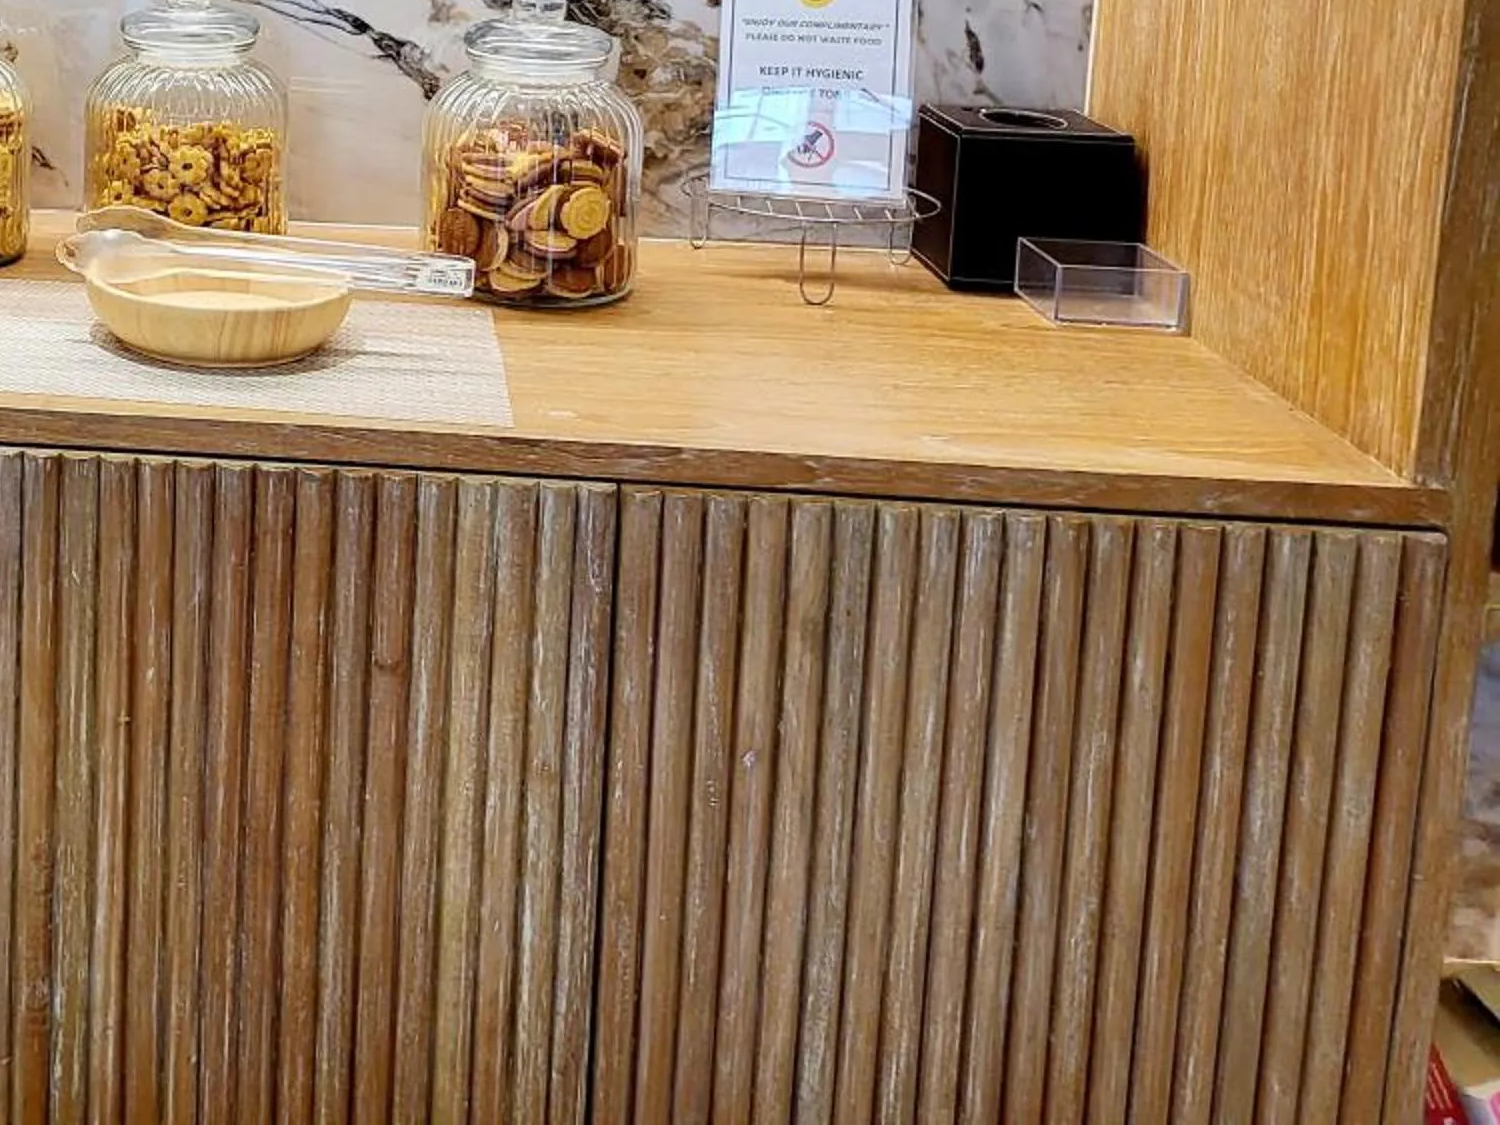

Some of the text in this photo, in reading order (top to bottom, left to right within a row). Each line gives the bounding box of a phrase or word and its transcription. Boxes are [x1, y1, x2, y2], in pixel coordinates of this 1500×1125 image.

[745, 33, 778, 41] PLEASE
[820, 35, 851, 44] WASTE
[853, 37, 882, 46] FOOD
[759, 66, 864, 80] KEEP IT HYGIENIC
